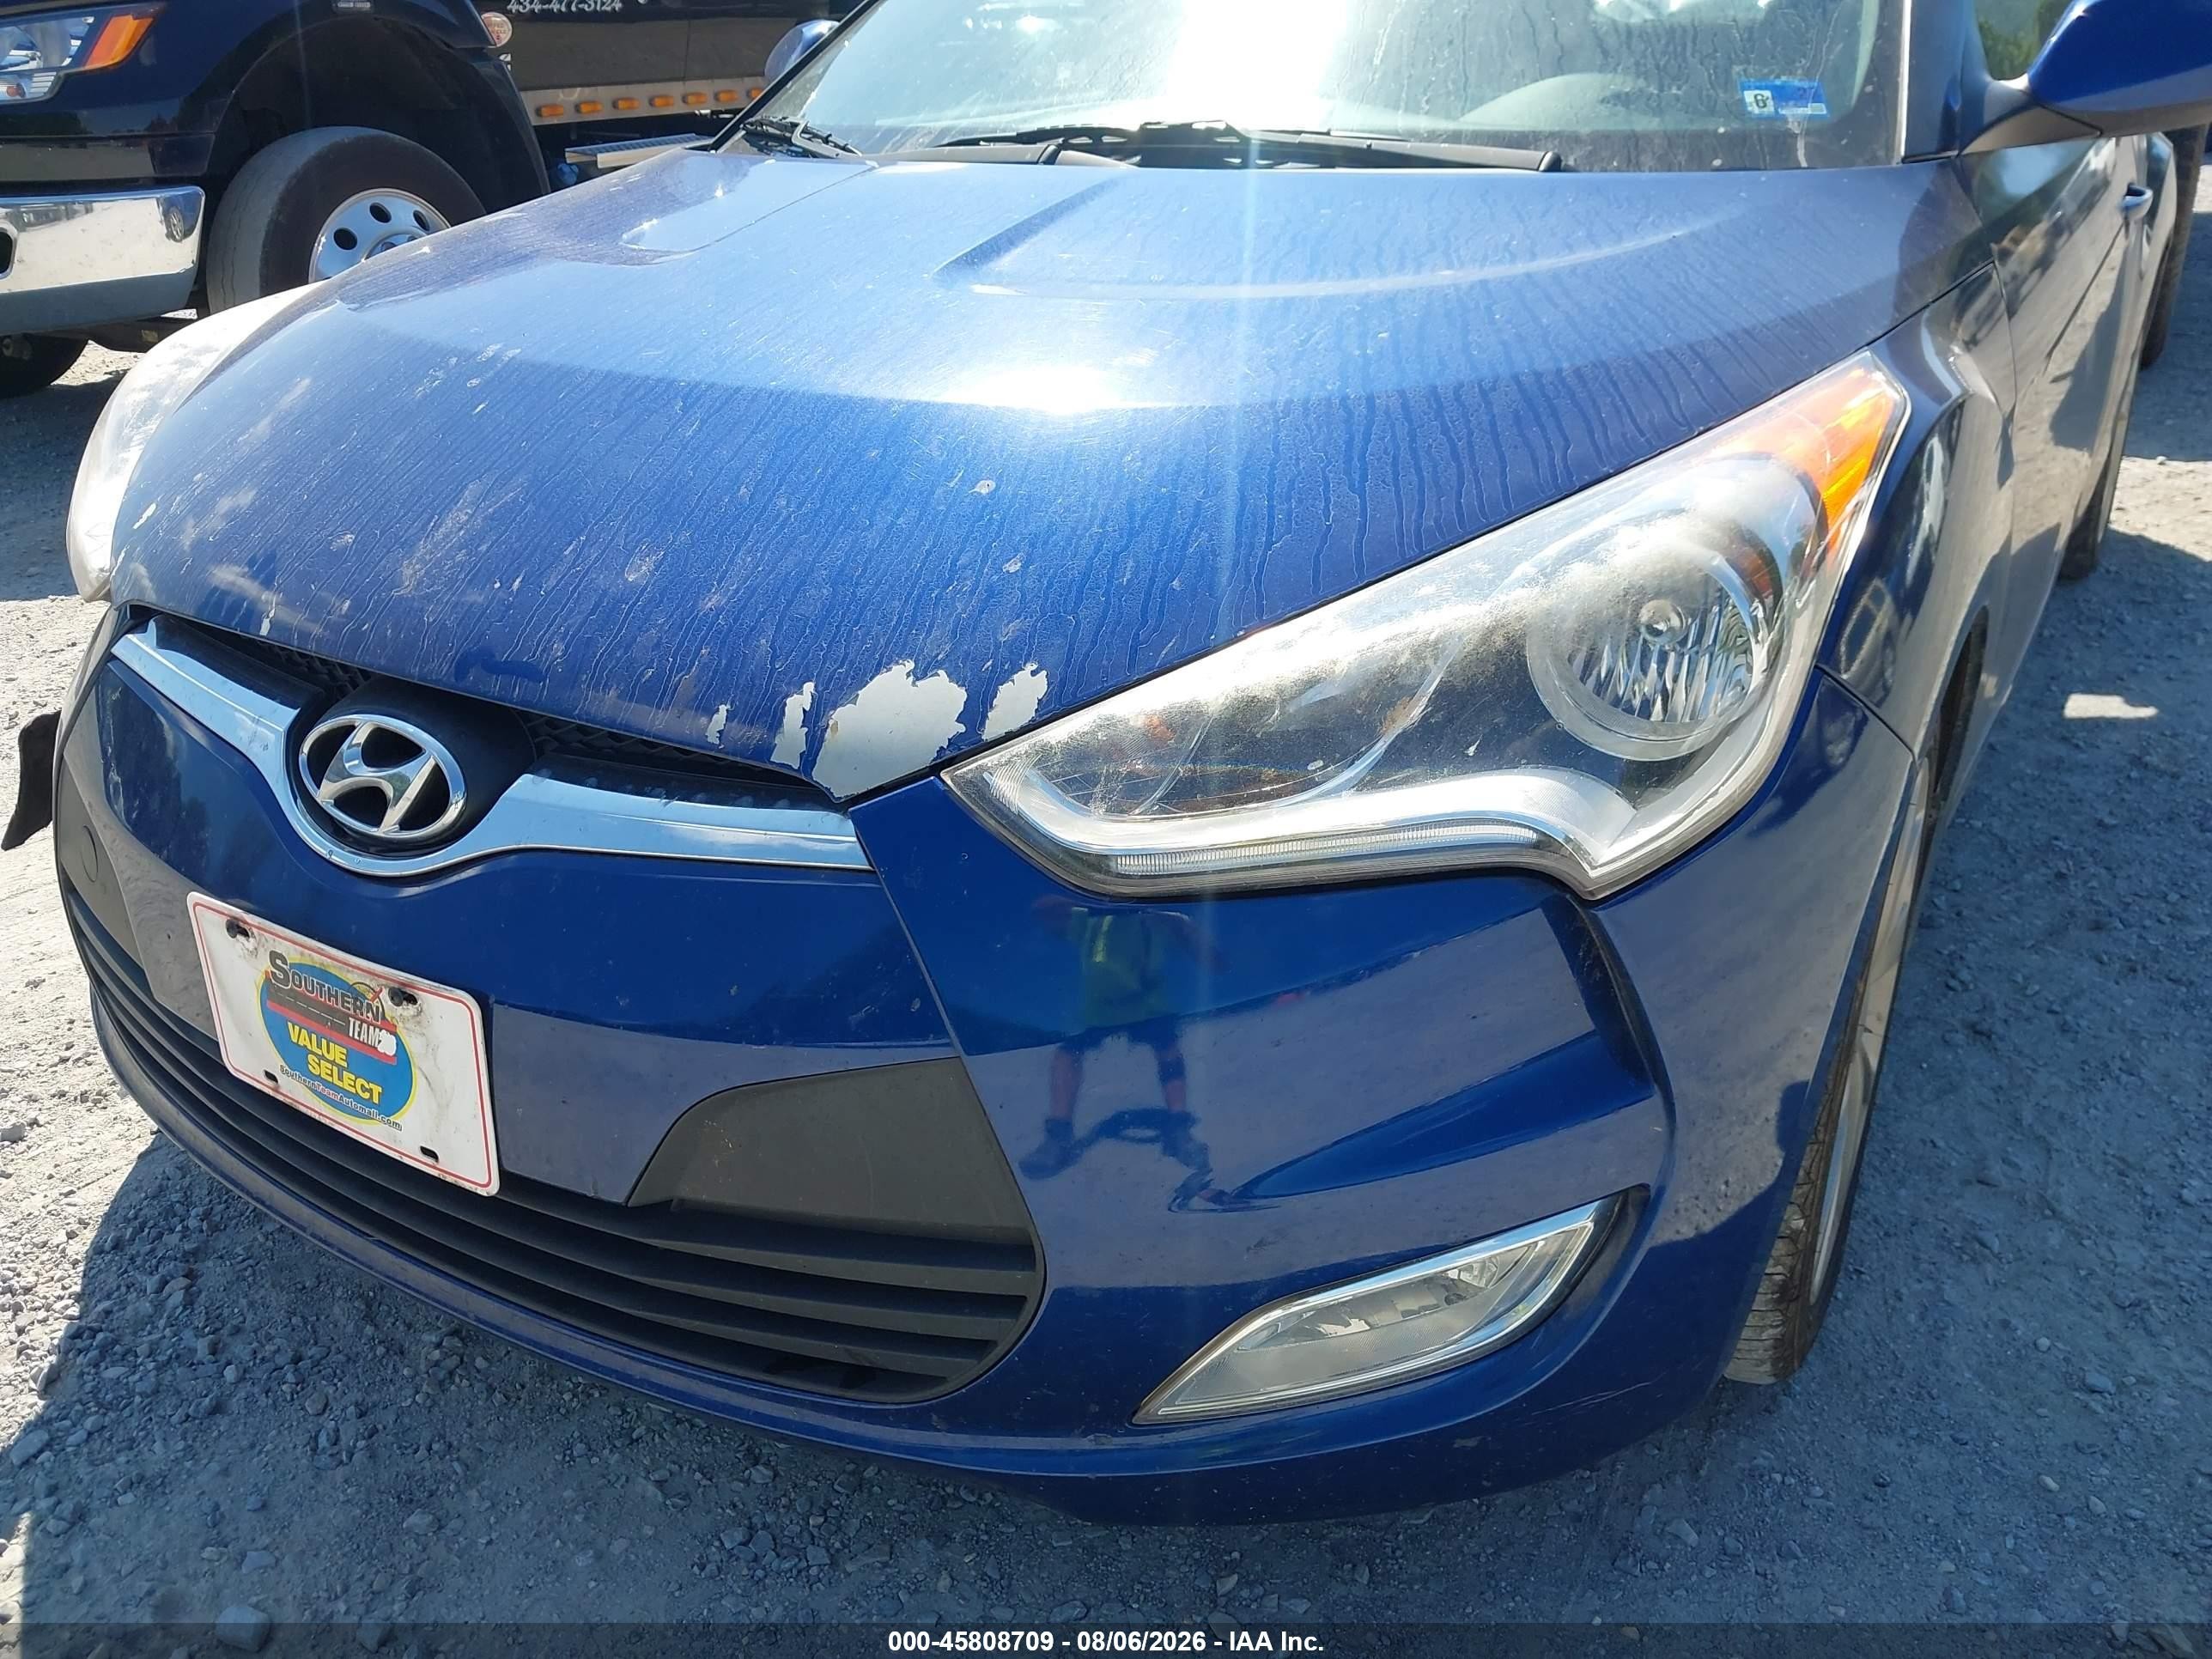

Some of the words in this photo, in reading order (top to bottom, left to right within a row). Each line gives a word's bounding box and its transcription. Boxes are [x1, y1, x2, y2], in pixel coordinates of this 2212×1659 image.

[269, 949, 381, 1025] SOUTHERN
[288, 1021, 348, 1068] VALUE
[279, 1064, 402, 1131] SouthernTeamAutomall.com
[307, 1054, 382, 1104] SELECT
